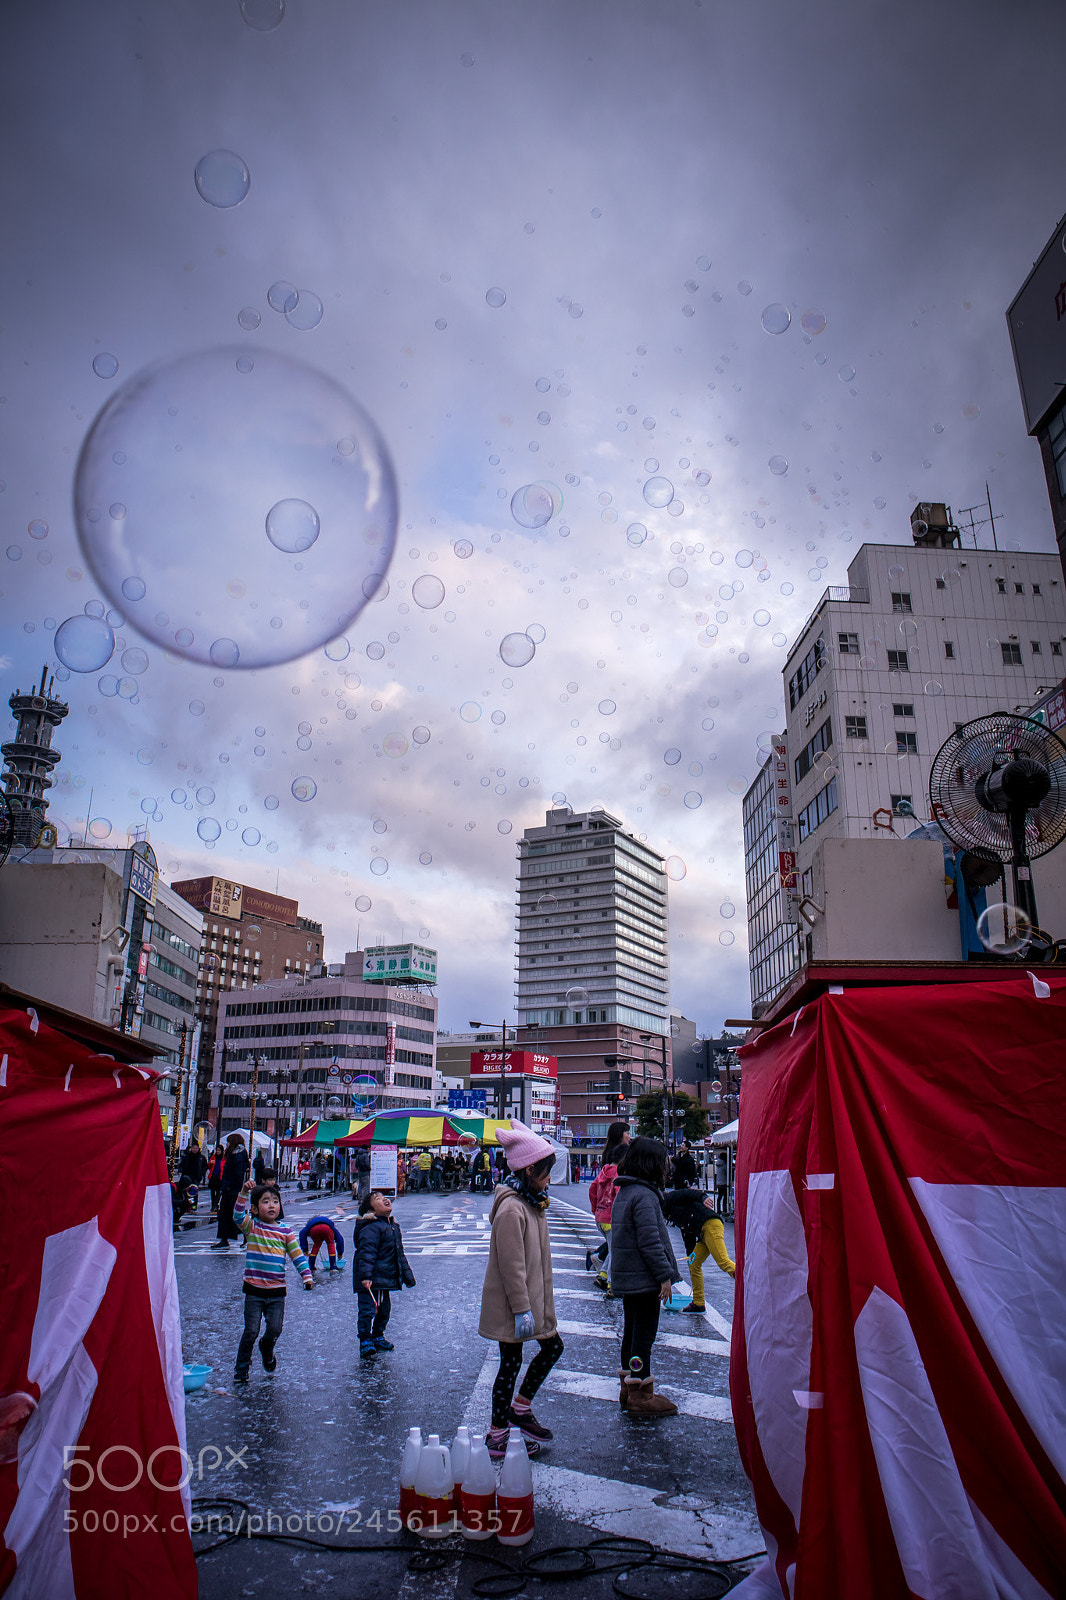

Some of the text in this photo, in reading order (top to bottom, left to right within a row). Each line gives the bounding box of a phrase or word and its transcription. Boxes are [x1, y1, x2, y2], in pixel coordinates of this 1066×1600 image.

[776, 745, 789, 805] 朝日生命
[131, 874, 152, 898] のトライ
[246, 896, 295, 917] COMODO HOTEL
[483, 1053, 512, 1061] カラオケ
[533, 1054, 549, 1064] カラオケ
